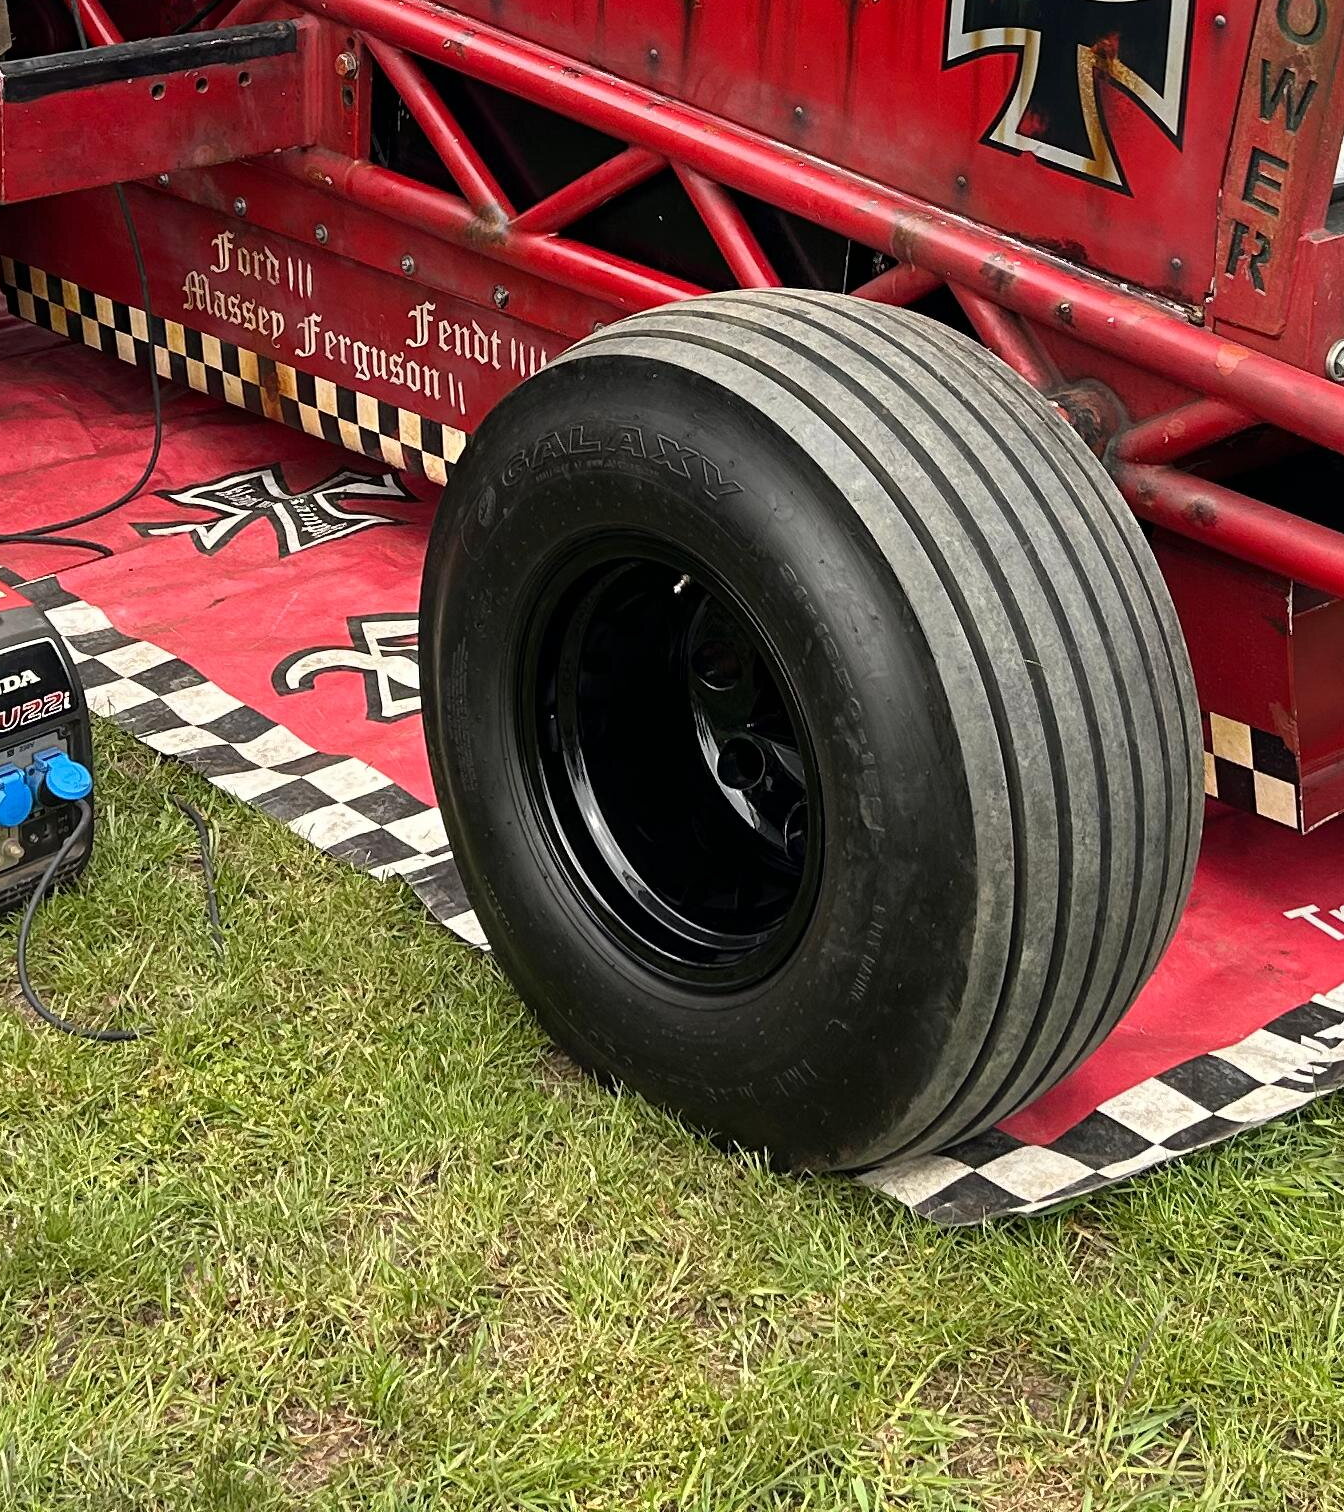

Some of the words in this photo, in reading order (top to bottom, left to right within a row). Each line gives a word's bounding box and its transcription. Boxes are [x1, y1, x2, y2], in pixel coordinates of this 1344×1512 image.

[210, 230, 280, 286] Ford
[182, 271, 285, 348] Massey
[295, 313, 441, 400] Ferguson
[406, 301, 502, 370] Fendt
[502, 425, 744, 500] GALAXY
